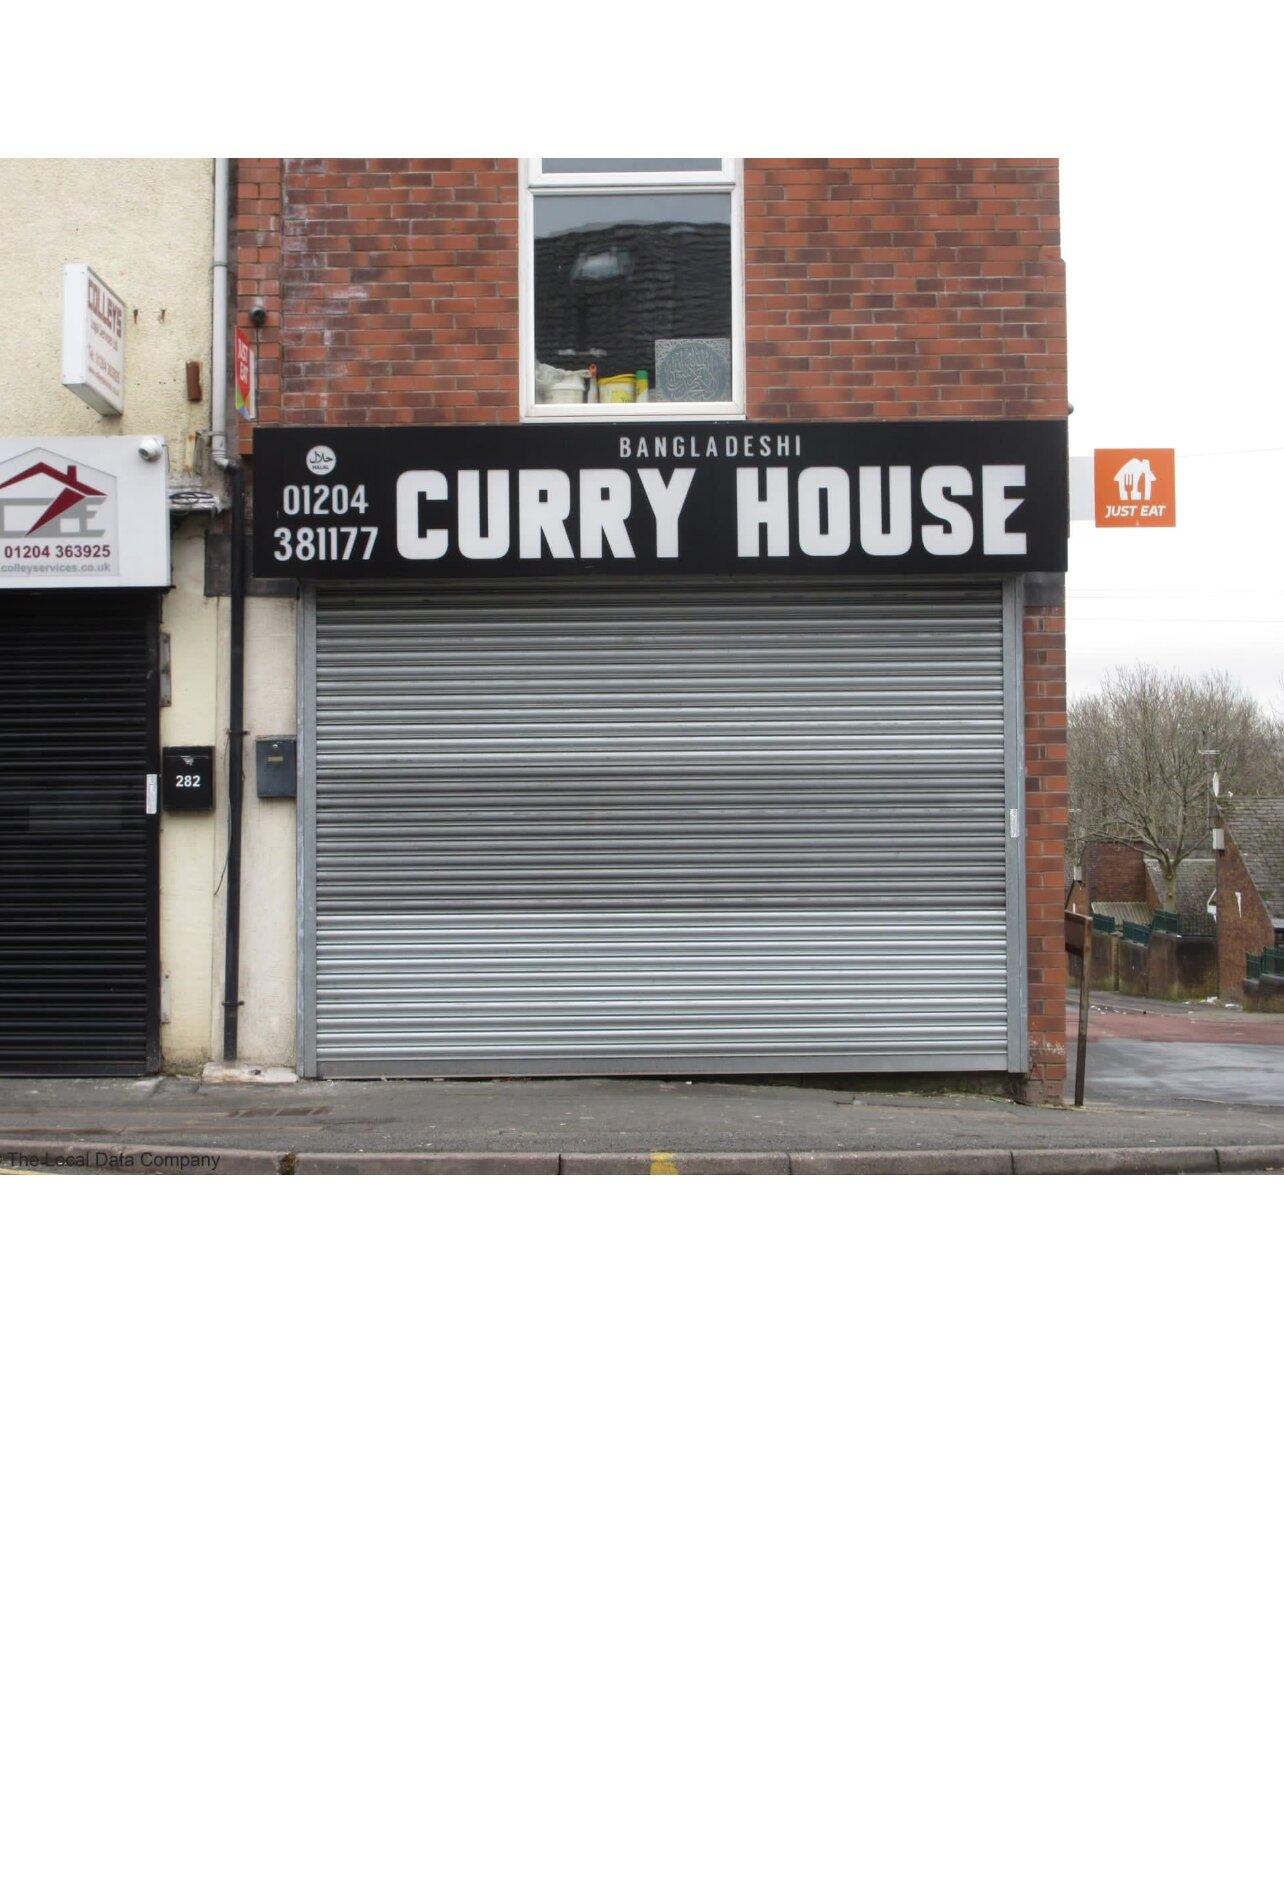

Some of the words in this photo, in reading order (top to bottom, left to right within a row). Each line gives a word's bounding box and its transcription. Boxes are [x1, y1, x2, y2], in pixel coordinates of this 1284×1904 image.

[619, 435, 803, 459] BANGLADESHI
[283, 484, 368, 515] 01204
[1105, 505, 1138, 518] JUST
[1140, 505, 1166, 517] EAT
[396, 468, 695, 560] CURRY
[737, 464, 1027, 557] HOUSE
[4, 545, 50, 559] 01204
[55, 544, 111, 558] 363925
[273, 526, 378, 562] 381177
[175, 775, 200, 788] 282
